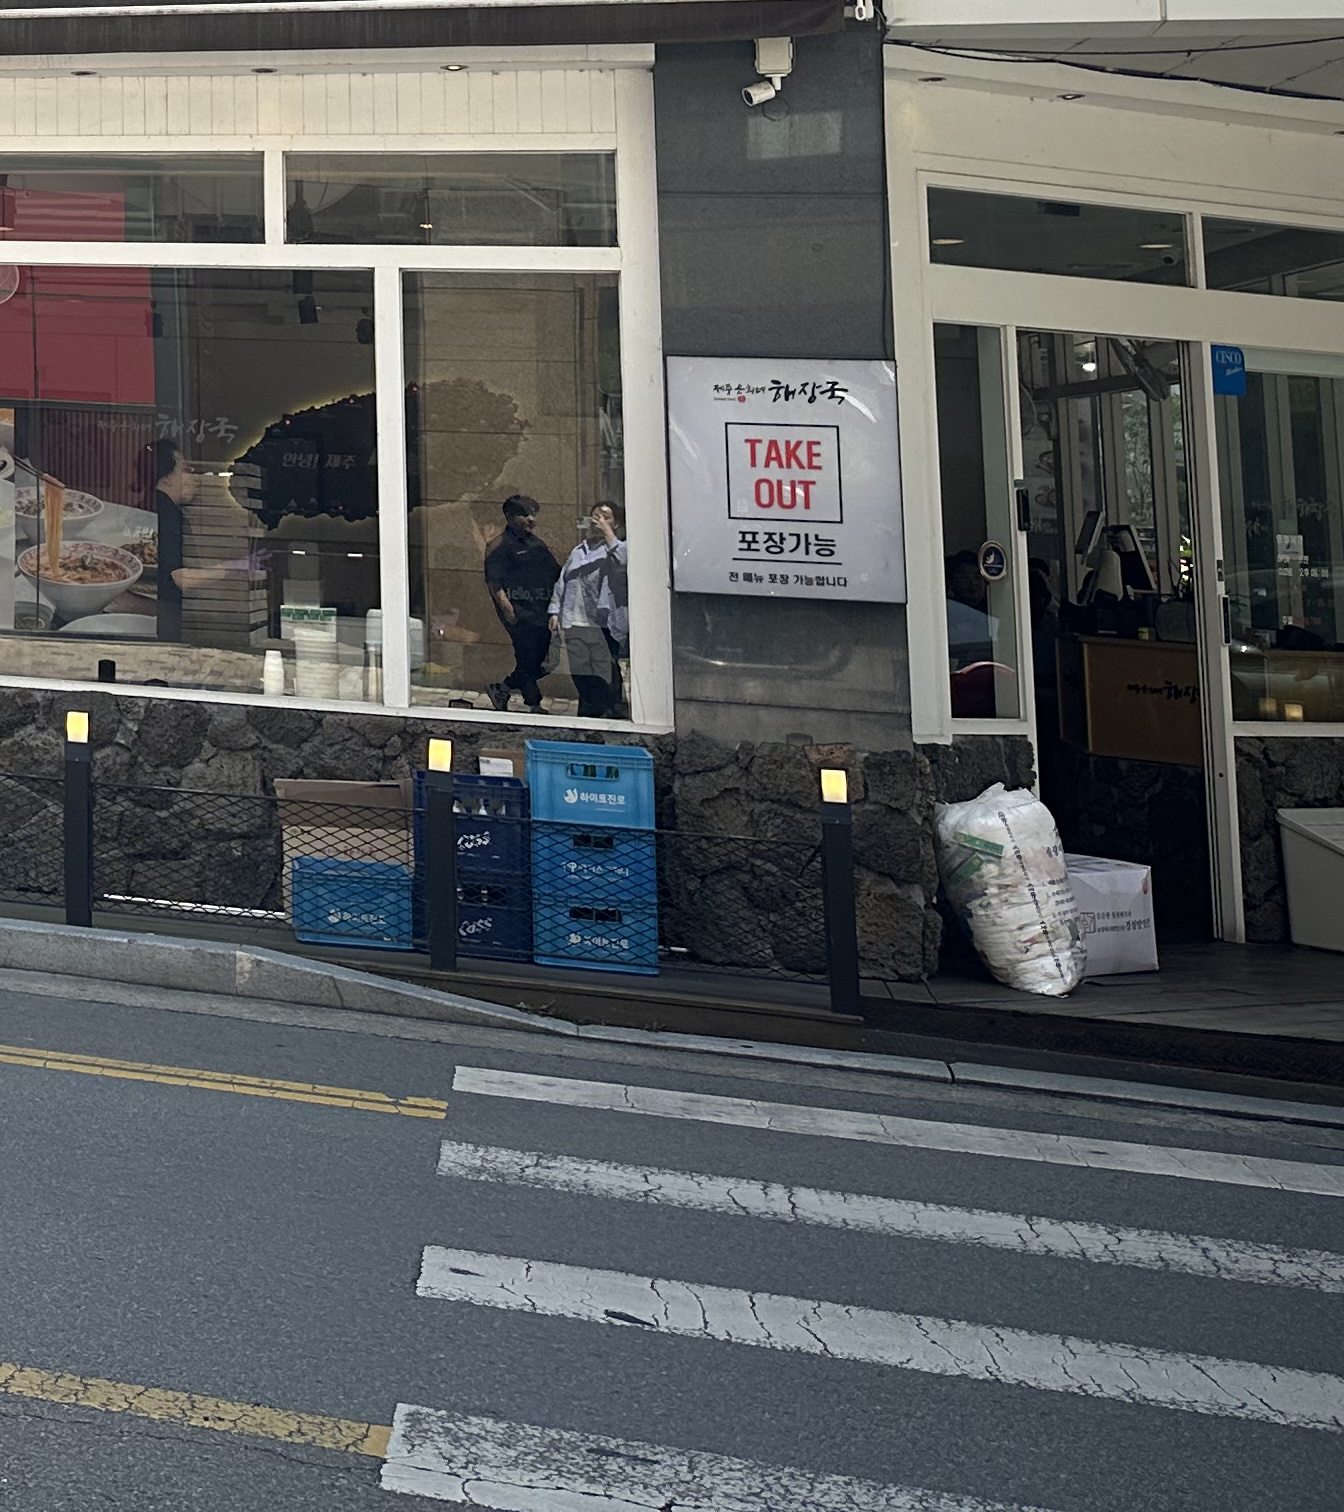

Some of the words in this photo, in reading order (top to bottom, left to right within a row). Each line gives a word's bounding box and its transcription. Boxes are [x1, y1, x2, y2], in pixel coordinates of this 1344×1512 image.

[1215, 349, 1243, 365] CESCO
[767, 379, 849, 405] 해장국
[155, 413, 239, 444] 해장국
[324, 453, 359, 470] 제주
[744, 438, 823, 471] TAKE
[754, 478, 817, 510] OUT
[738, 530, 837, 558] 포장가능
[728, 571, 740, 583] 전
[742, 572, 764, 584] 메뉴
[768, 573, 790, 586] 포장
[794, 574, 848, 588] 가능합니다
